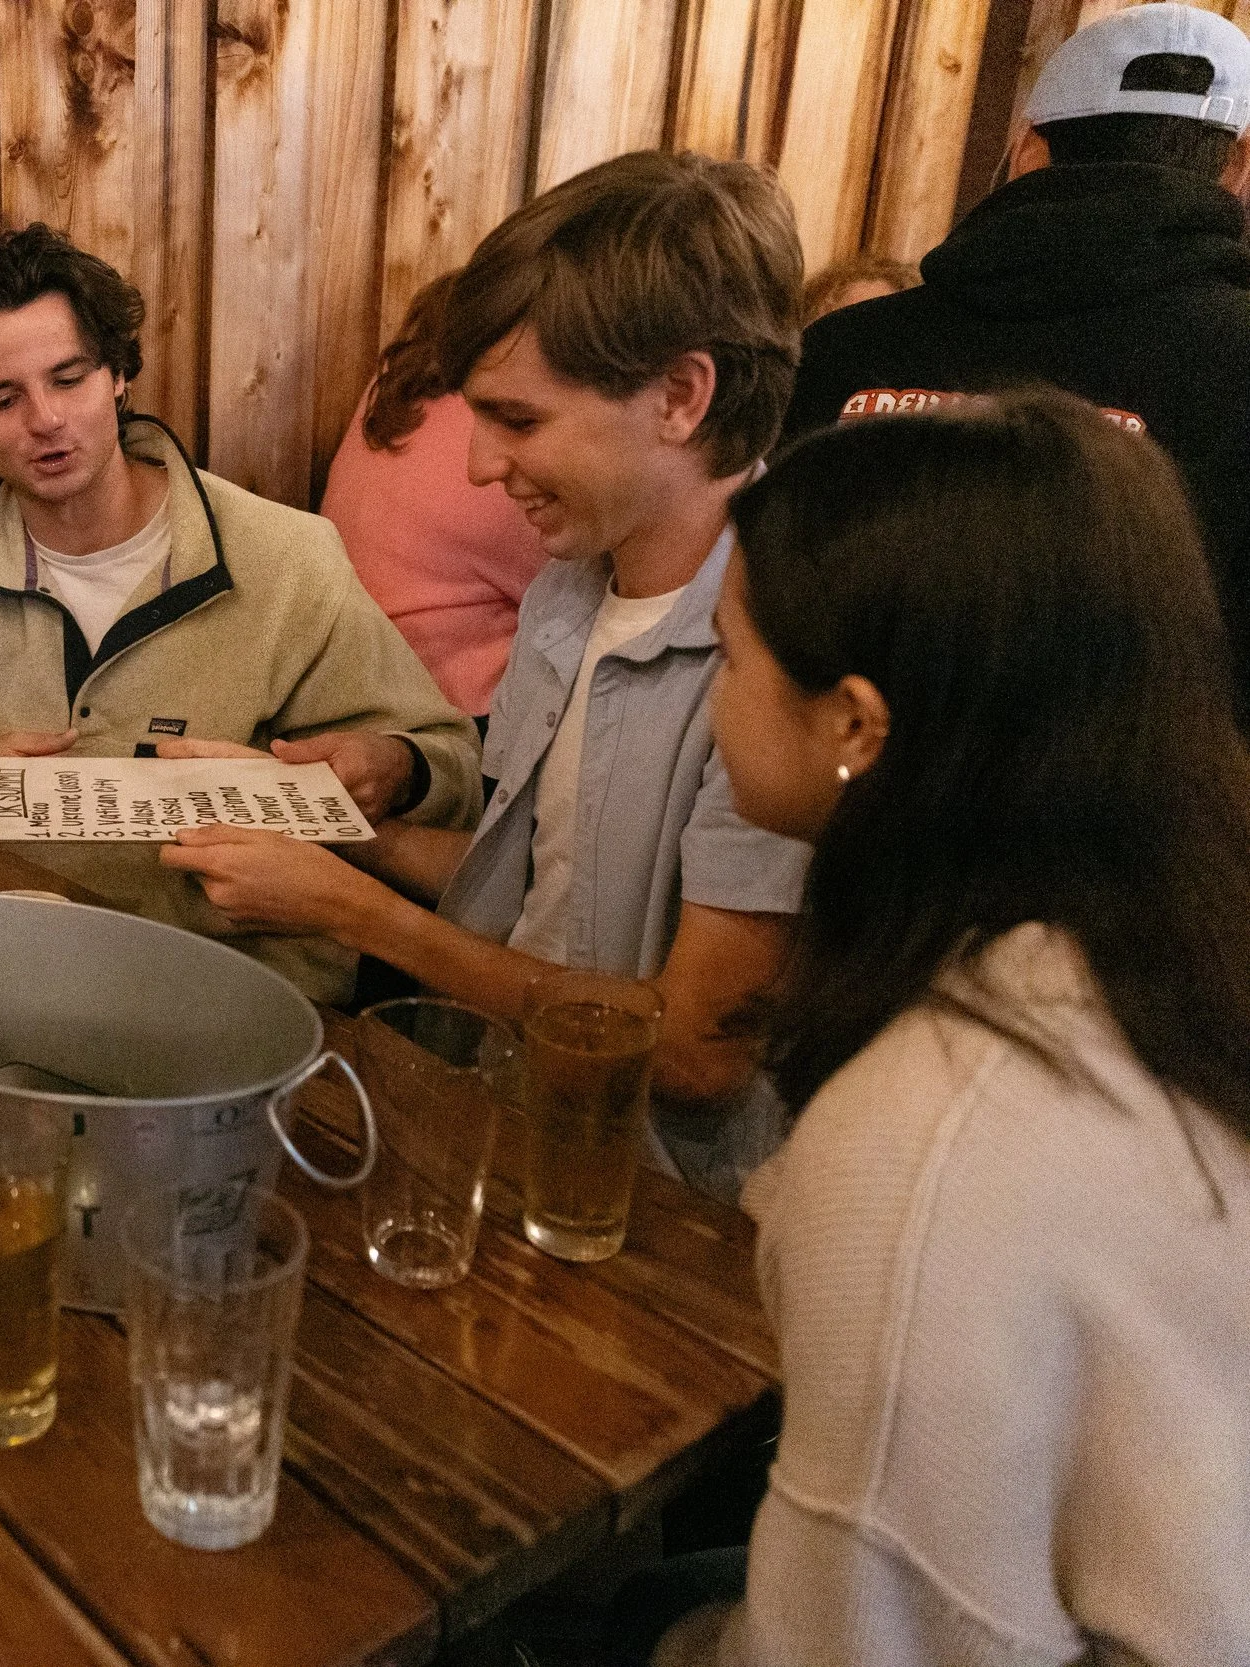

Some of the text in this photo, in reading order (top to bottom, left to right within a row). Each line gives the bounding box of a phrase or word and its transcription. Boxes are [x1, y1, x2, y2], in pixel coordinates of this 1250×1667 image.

[24, 803, 52, 838] 1. Mexico
[54, 770, 86, 838] 2. Ukraine (USSR)
[95, 794, 126, 826] Vatican
[129, 799, 162, 838] 4. Alaska
[157, 797, 189, 826] Russia
[184, 791, 223, 825] Canada
[215, 786, 256, 825] California
[252, 793, 291, 825] Denver
[276, 782, 320, 825] Antarctica
[312, 796, 363, 837] 10. Florida
[92, 828, 125, 838] 3.
